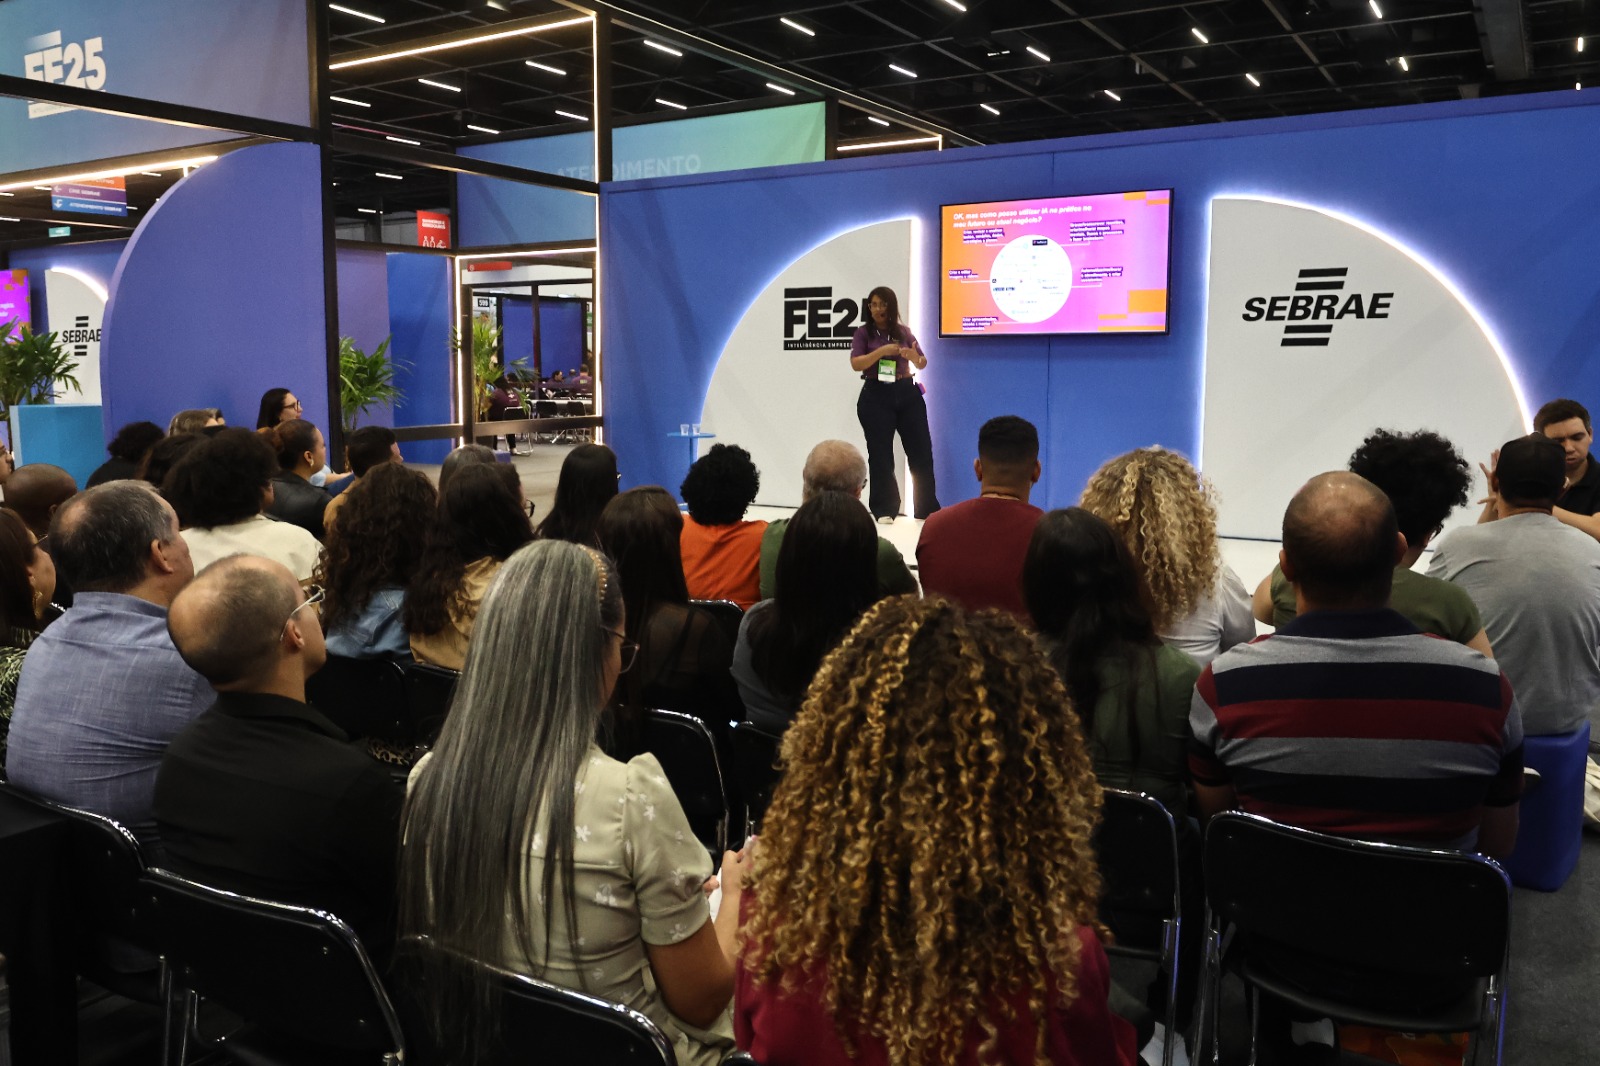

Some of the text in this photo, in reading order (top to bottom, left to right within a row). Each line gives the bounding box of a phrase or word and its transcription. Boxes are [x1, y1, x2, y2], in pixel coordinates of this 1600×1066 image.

[24, 37, 106, 90] FE25
[556, 154, 701, 181] ATEDIMENTO
[1242, 292, 1394, 321] SEBRAE
[62, 329, 101, 343] SEBRAE
